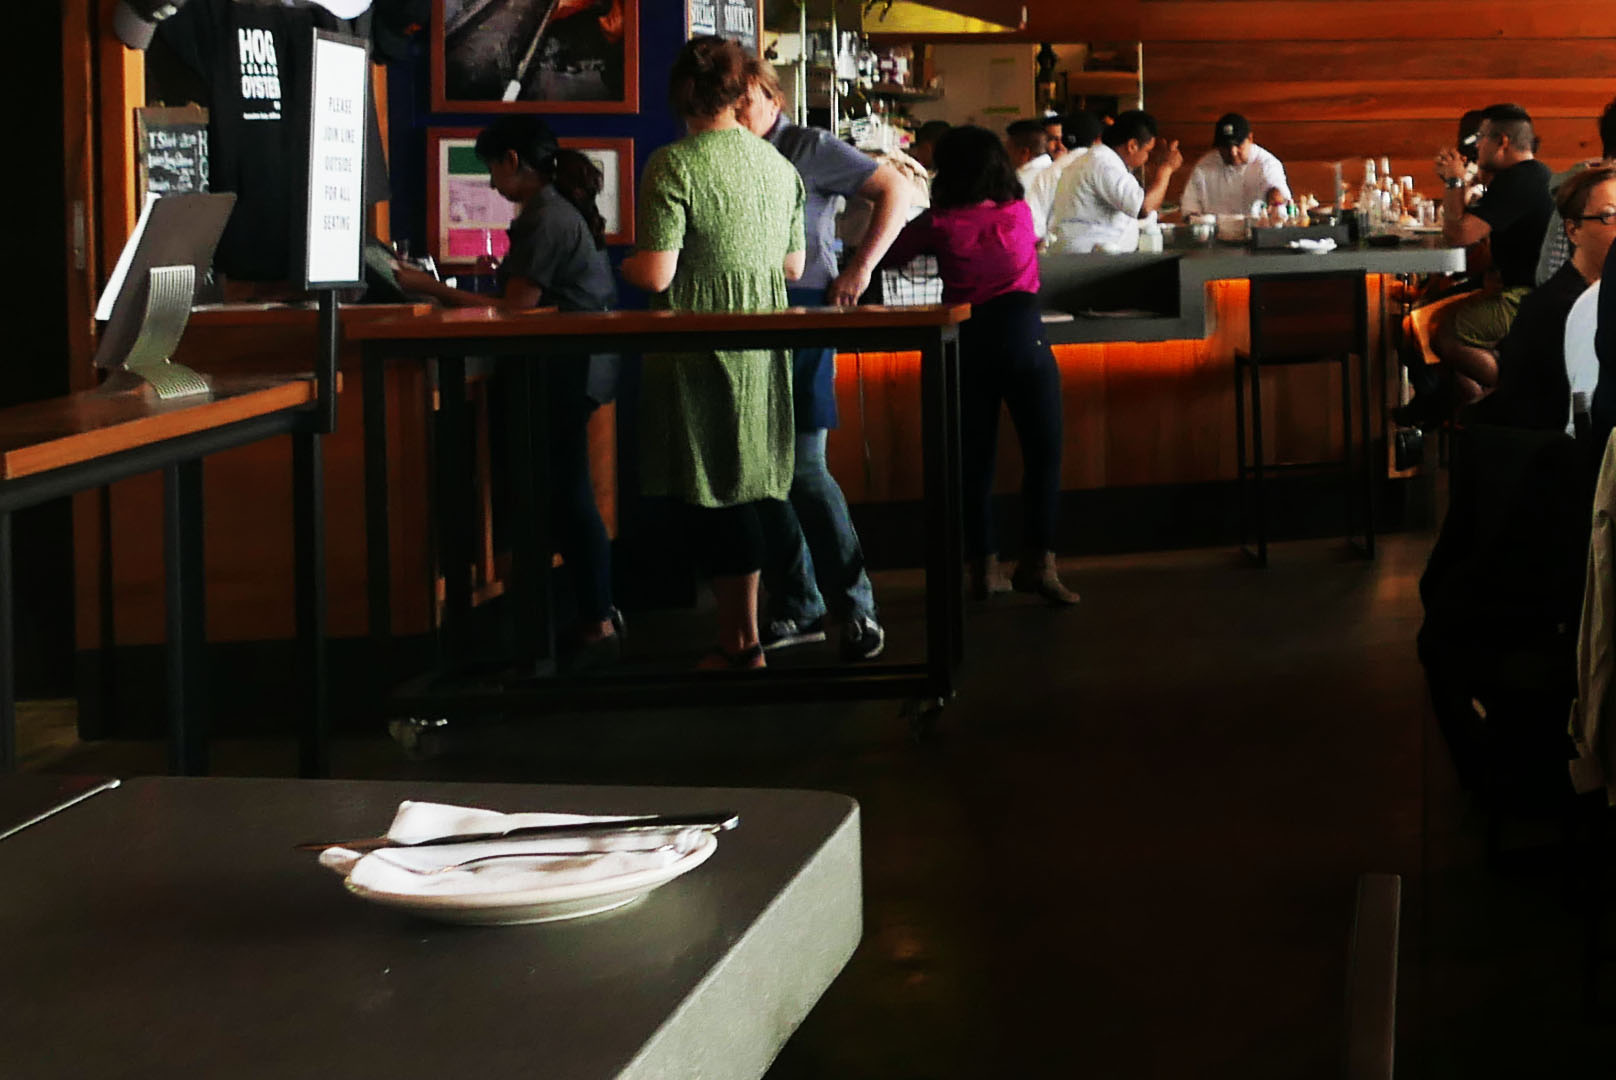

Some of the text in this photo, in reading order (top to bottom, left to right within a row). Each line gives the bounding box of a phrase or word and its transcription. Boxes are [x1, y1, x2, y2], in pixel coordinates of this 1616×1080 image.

[238, 28, 277, 65] HOG
[241, 75, 281, 100] OYSTER
[327, 95, 353, 114] PLEASE
[323, 125, 356, 144] JOIN LINE
[324, 154, 353, 174] OUTSIDE
[323, 184, 352, 202] FOR ALL
[322, 214, 351, 232] SEATING
